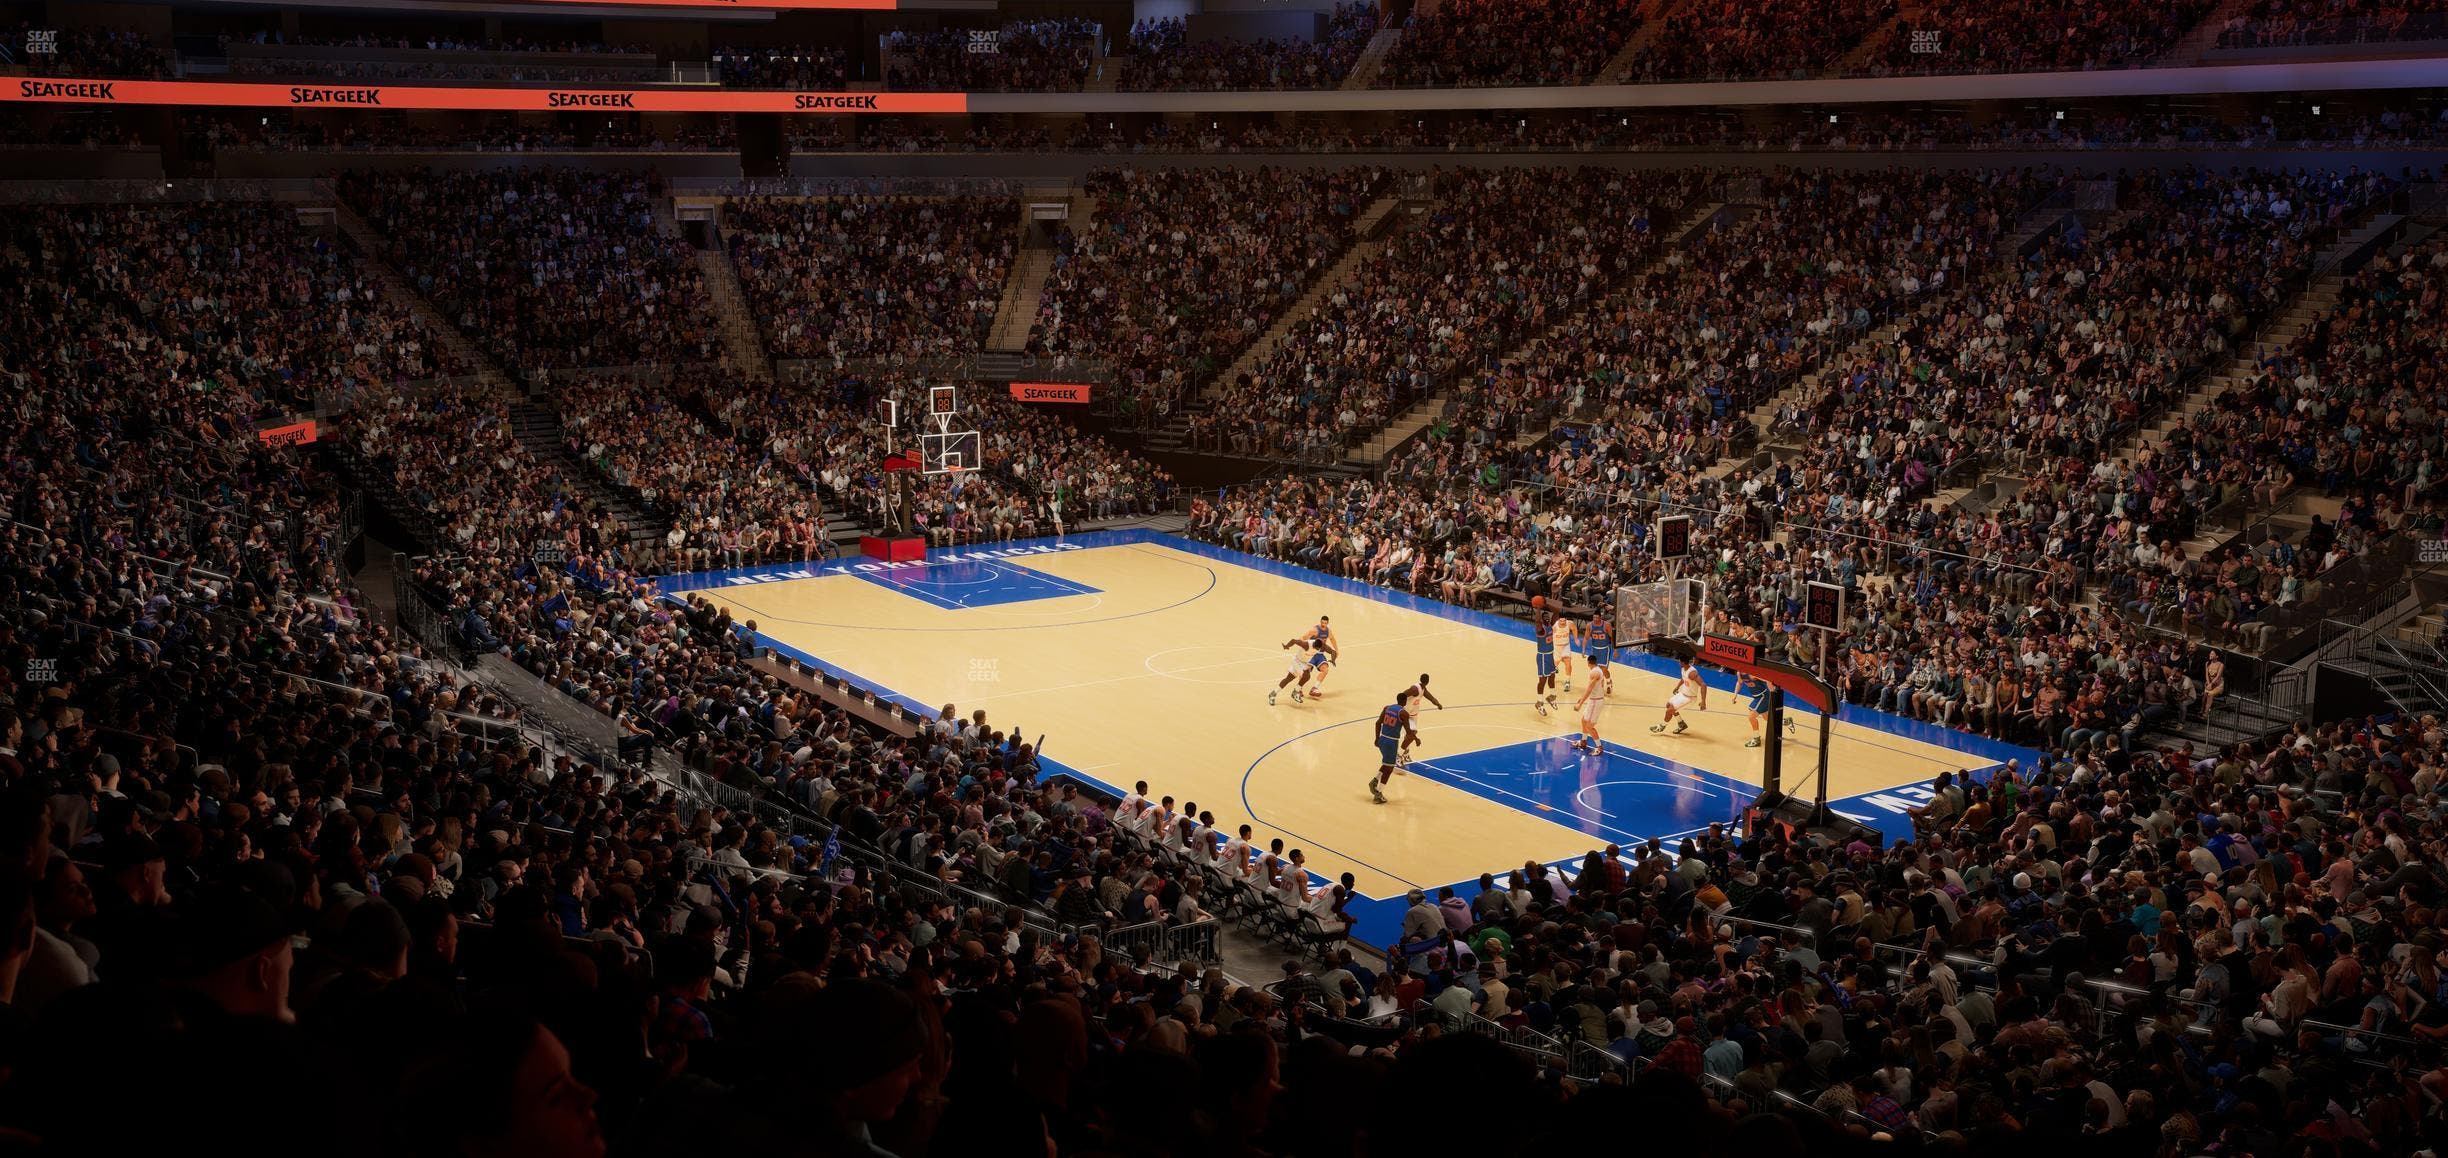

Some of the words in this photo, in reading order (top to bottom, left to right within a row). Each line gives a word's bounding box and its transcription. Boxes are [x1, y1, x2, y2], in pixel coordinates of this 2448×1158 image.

[21, 81, 115, 100] SEATGEEK
[290, 87, 380, 105] SEATGEEK
[548, 92, 634, 108] SEATGEEK
[795, 94, 877, 109] SEATGEEK
[1024, 388, 1077, 400] SEATGEEK
[727, 570, 813, 585] NEW
[938, 543, 1083, 562] KNICKS
[1710, 641, 1748, 658] SEATGEEK
